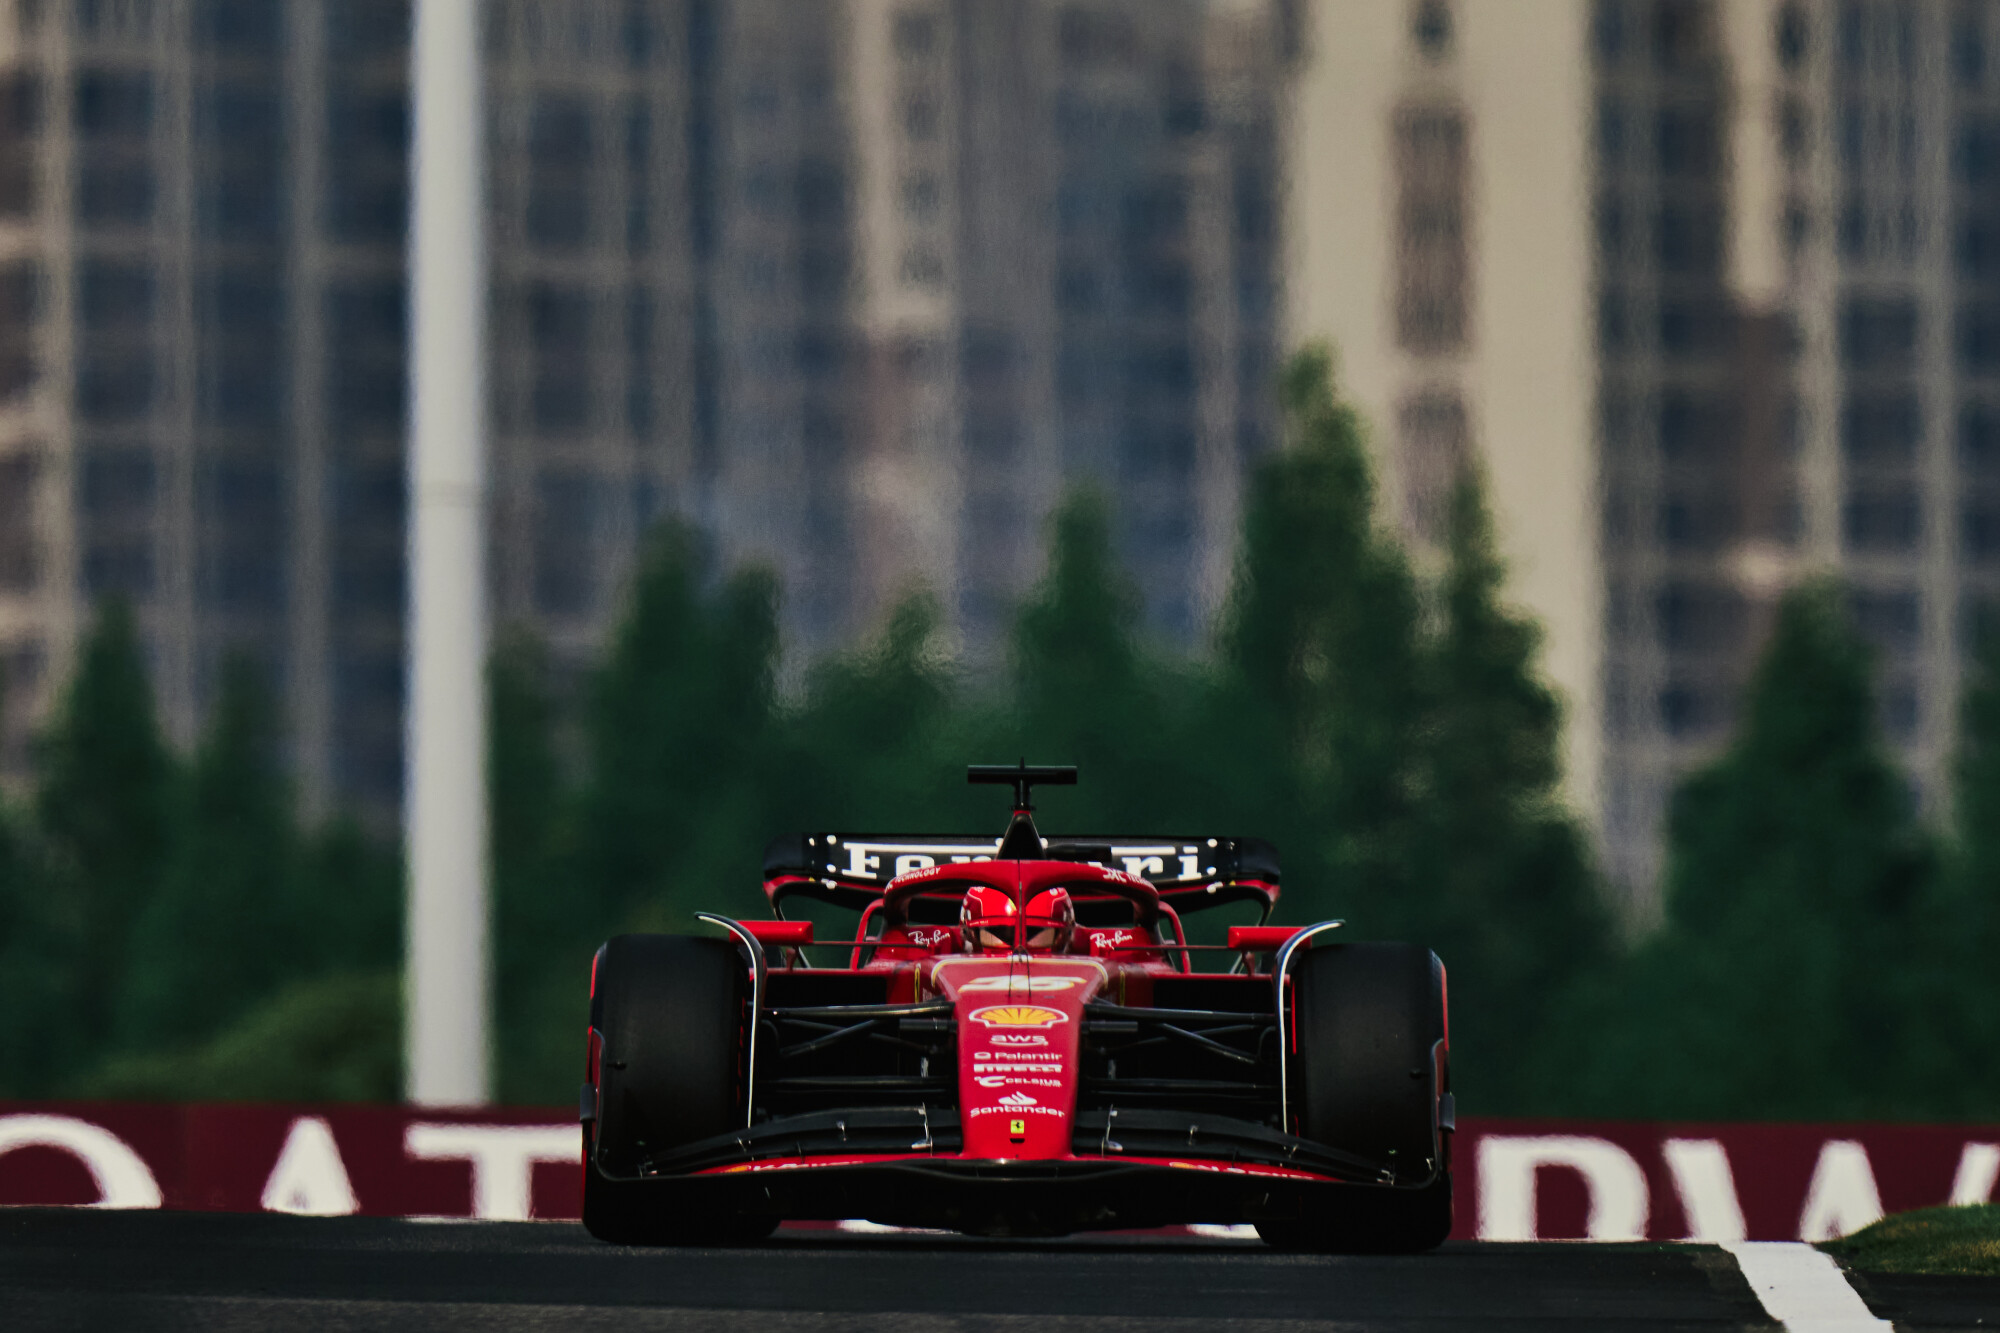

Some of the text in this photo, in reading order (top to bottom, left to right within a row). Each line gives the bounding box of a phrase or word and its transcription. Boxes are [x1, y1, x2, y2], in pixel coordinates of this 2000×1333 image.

[908, 929, 951, 948] Ray-Ban
[1090, 930, 1133, 950] Ray-Ban
[990, 1035, 1047, 1044] aws
[995, 1052, 1062, 1061] Palantir
[970, 1105, 1065, 1118] Santander
